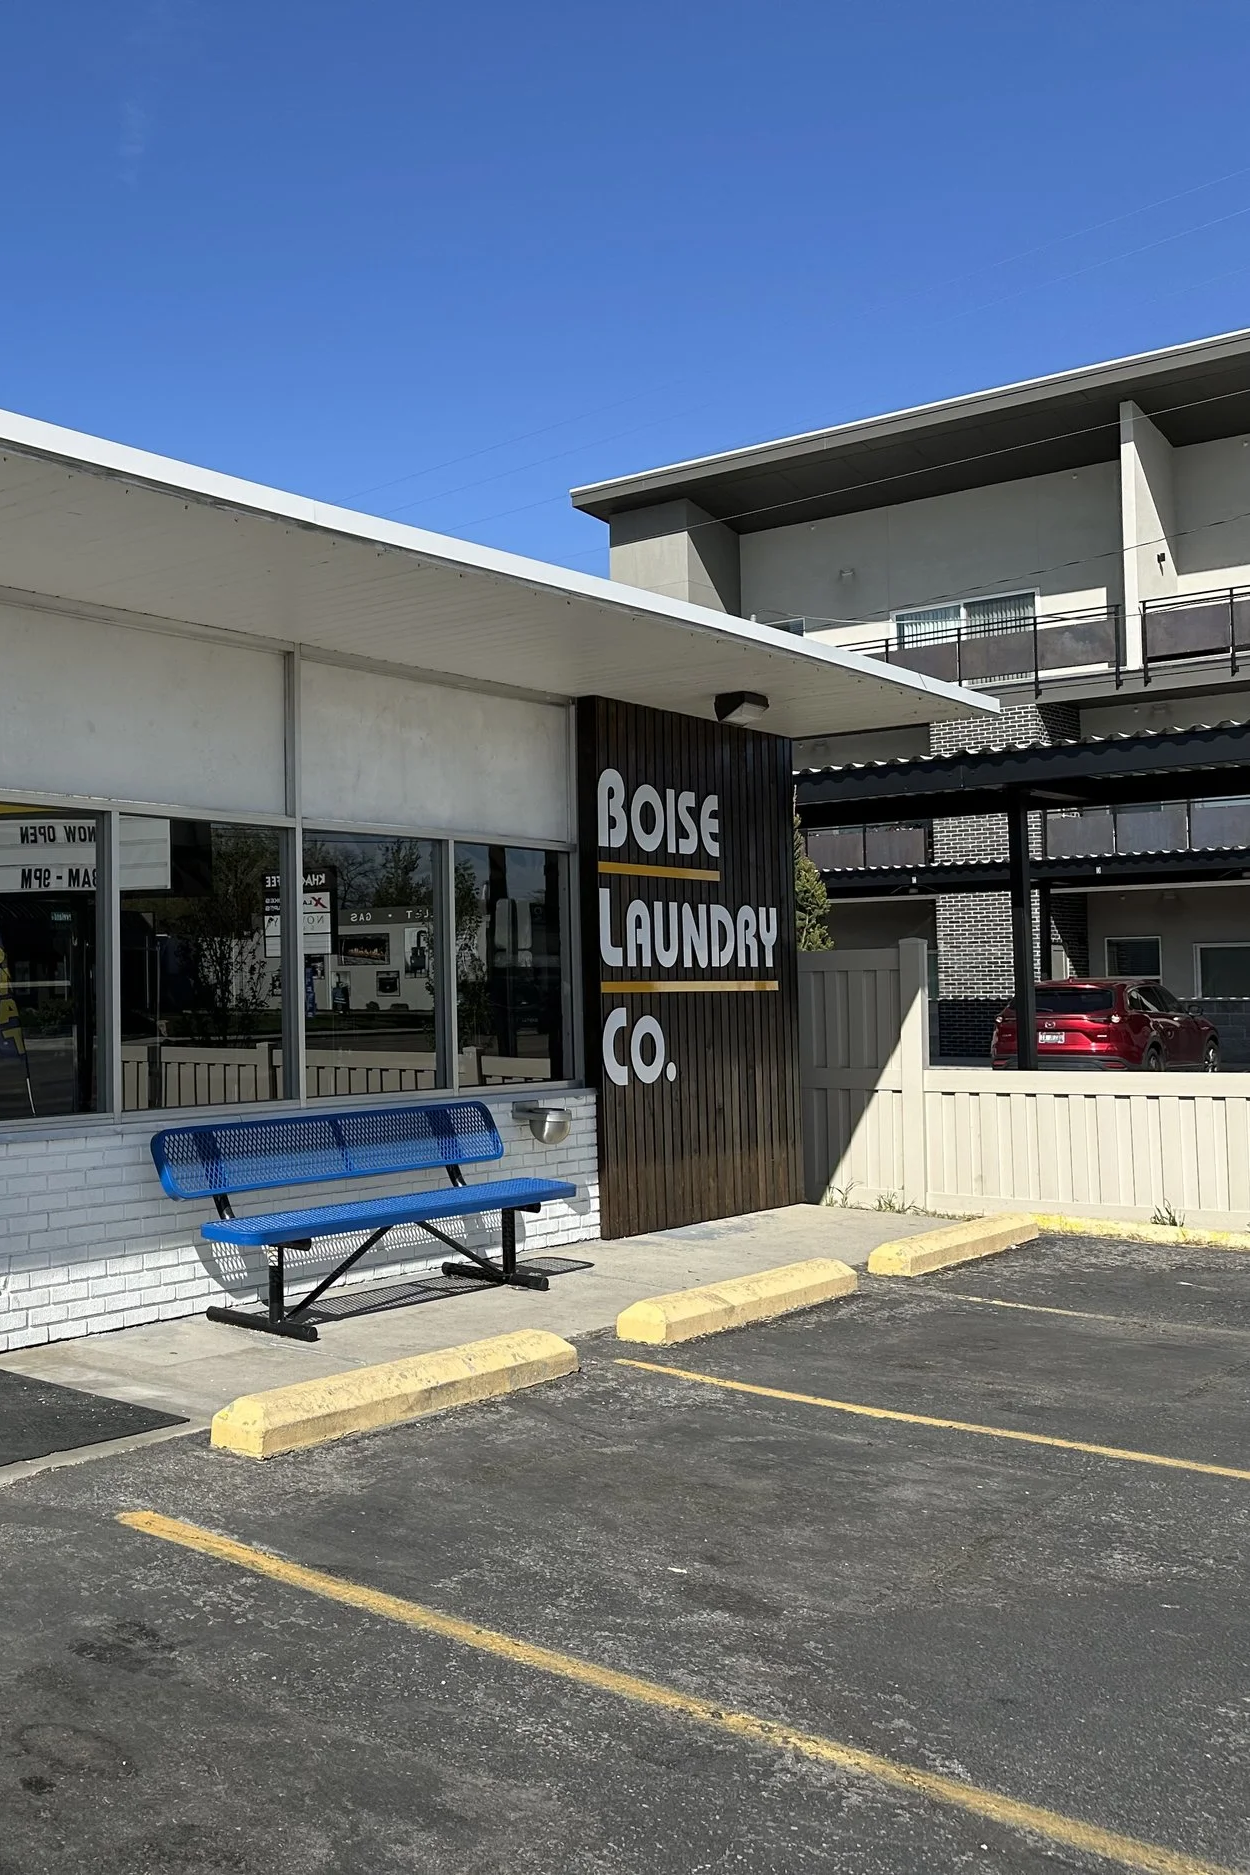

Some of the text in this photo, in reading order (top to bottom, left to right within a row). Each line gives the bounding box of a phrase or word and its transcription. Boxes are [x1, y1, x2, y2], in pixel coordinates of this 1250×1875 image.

[598, 768, 720, 858] BOISE
[599, 888, 777, 968] LAUNDRY
[602, 1007, 677, 1086] CO.
